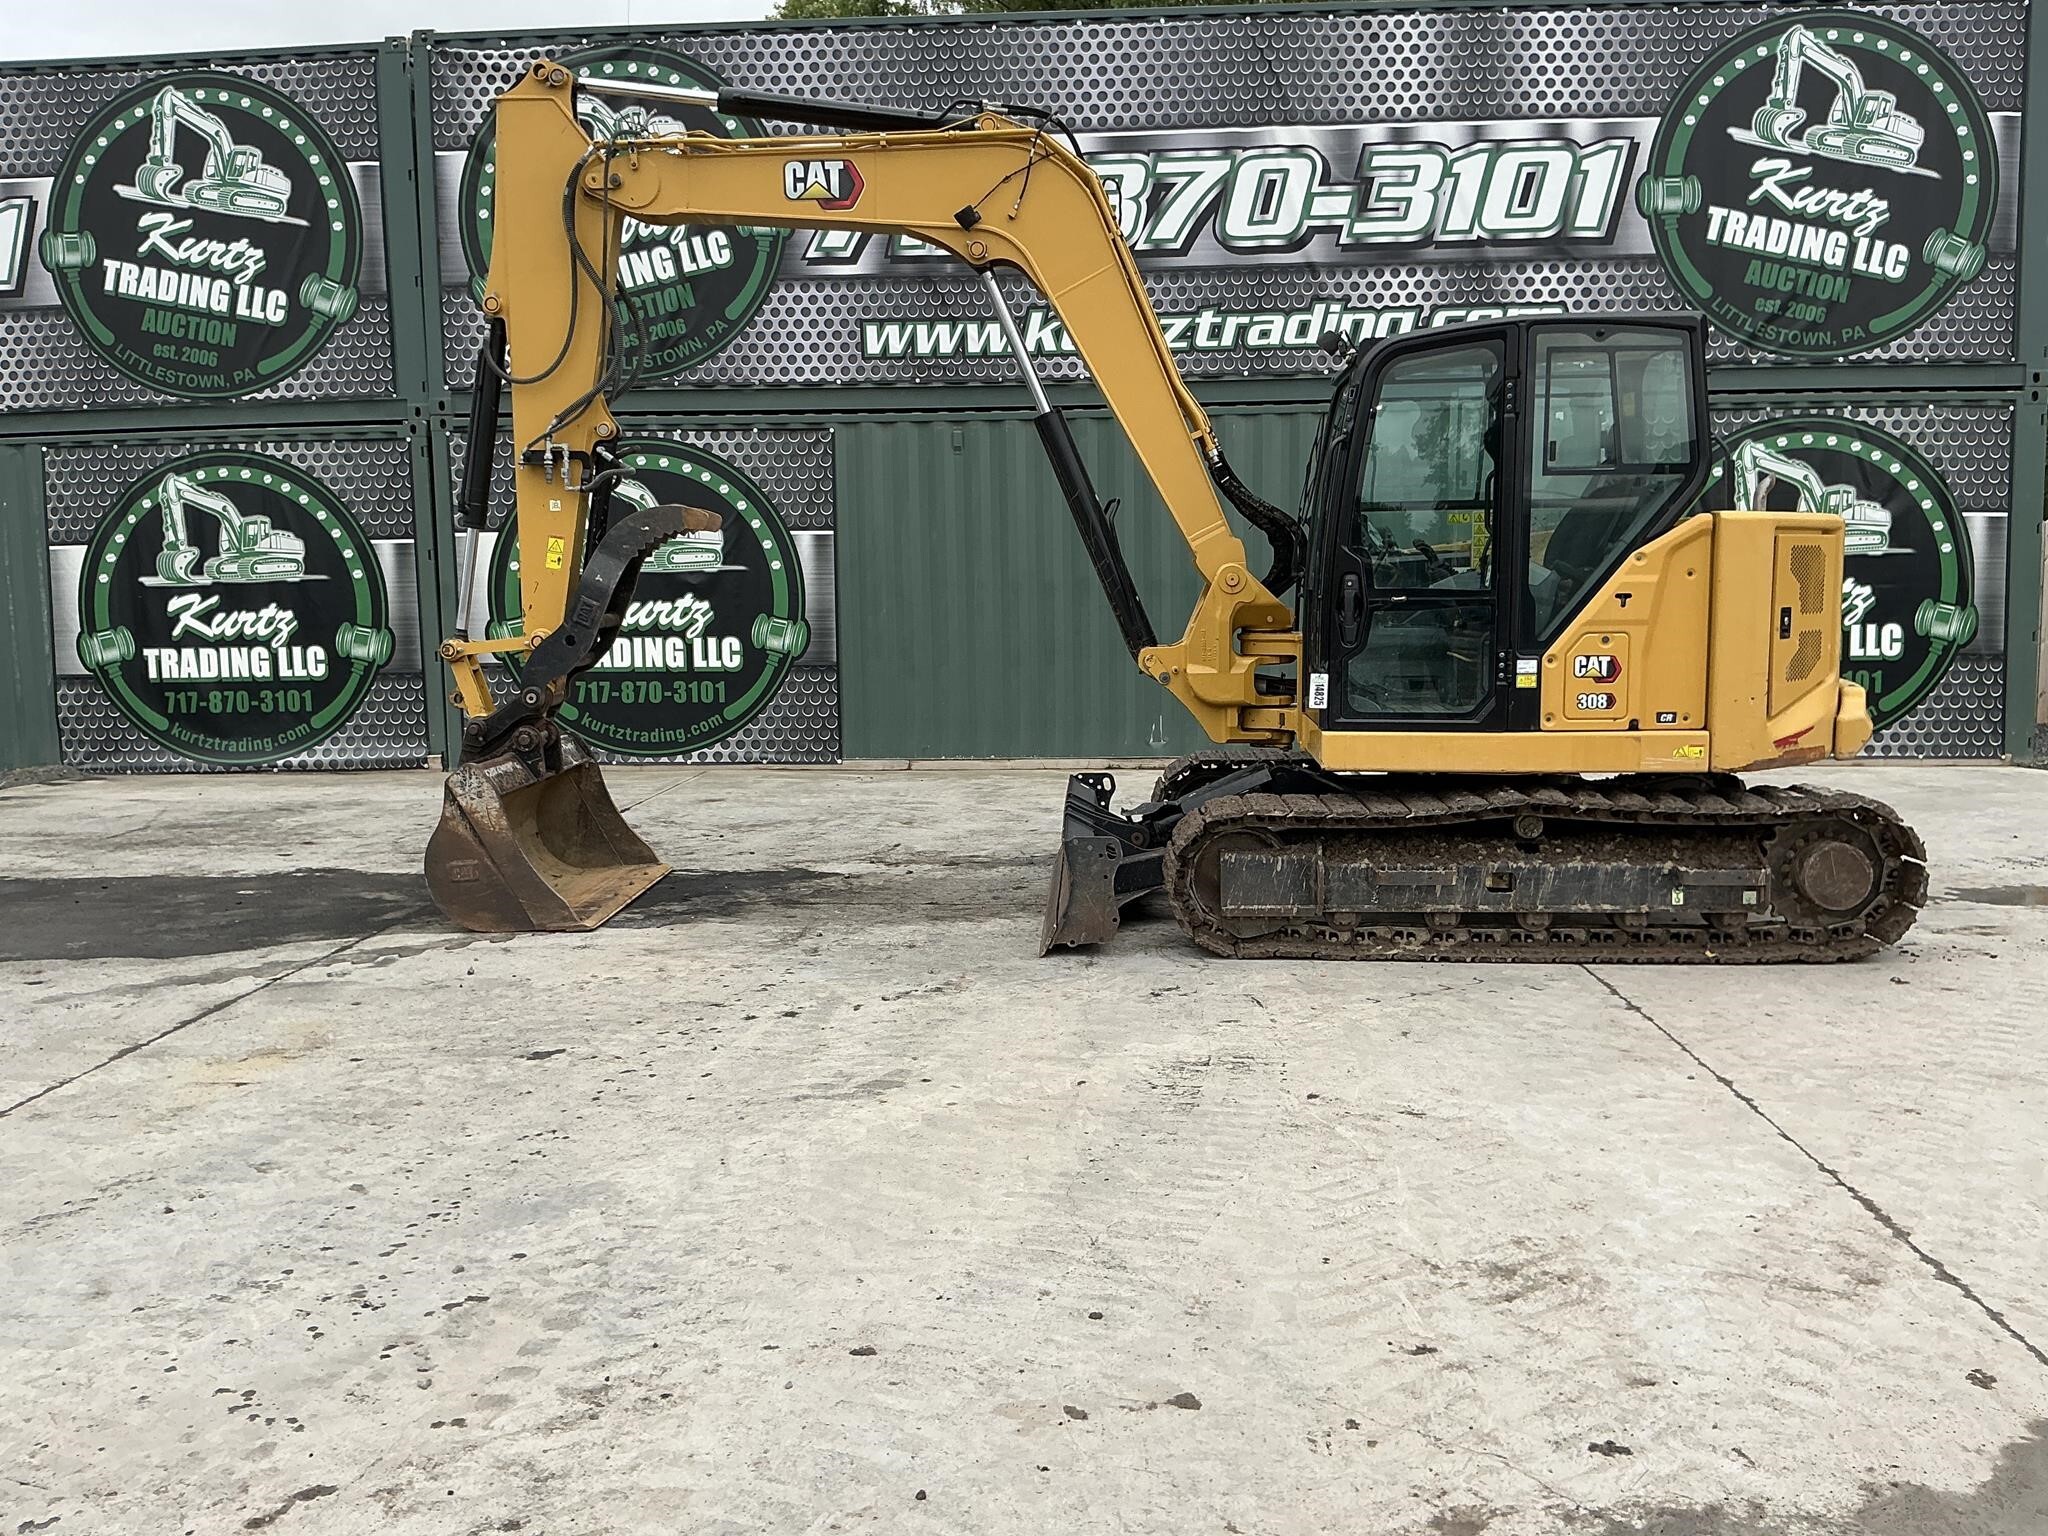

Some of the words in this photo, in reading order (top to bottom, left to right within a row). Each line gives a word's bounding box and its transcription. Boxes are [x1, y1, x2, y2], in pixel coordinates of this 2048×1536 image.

[785, 161, 845, 200] CAT
[1748, 157, 1890, 238] Kurtz
[136, 212, 266, 284] Kurtz
[678, 230, 732, 274] LLC
[1706, 206, 1849, 267] TRADING
[1852, 237, 1911, 280] LLC
[103, 258, 230, 313] TRADING
[236, 284, 290, 324] LLC
[1744, 259, 1852, 303] AUCTION
[616, 282, 696, 325] UCTION
[1754, 297, 1783, 316] est.
[1786, 303, 1826, 324] 2006
[141, 307, 237, 347] AUCTION
[650, 318, 687, 342] 2006
[705, 320, 728, 341] PA
[1711, 297, 1838, 347] LITTLESTOWN,
[1841, 326, 1866, 343] PA
[113, 344, 231, 388] LITTLESTOWN,
[233, 367, 256, 383] PA
[153, 342, 180, 359] est.
[182, 346, 218, 368] 2006
[167, 592, 298, 648] Kurtz
[619, 592, 714, 639] urtz
[592, 636, 685, 669] ADING
[692, 636, 742, 669] LLC
[1849, 622, 1904, 658] LLC
[143, 647, 273, 680] TRADING
[278, 645, 328, 679] LLC
[1574, 655, 1611, 678] CAT
[164, 690, 313, 714] 717-870-3101
[575, 681, 727, 705] 717-870-3101
[1314, 683, 1325, 706] 14825
[1577, 693, 1608, 710] 308
[580, 712, 723, 744] kurtztrading.com
[1660, 713, 1673, 722] CR
[171, 720, 311, 753] kurtztrading.com
